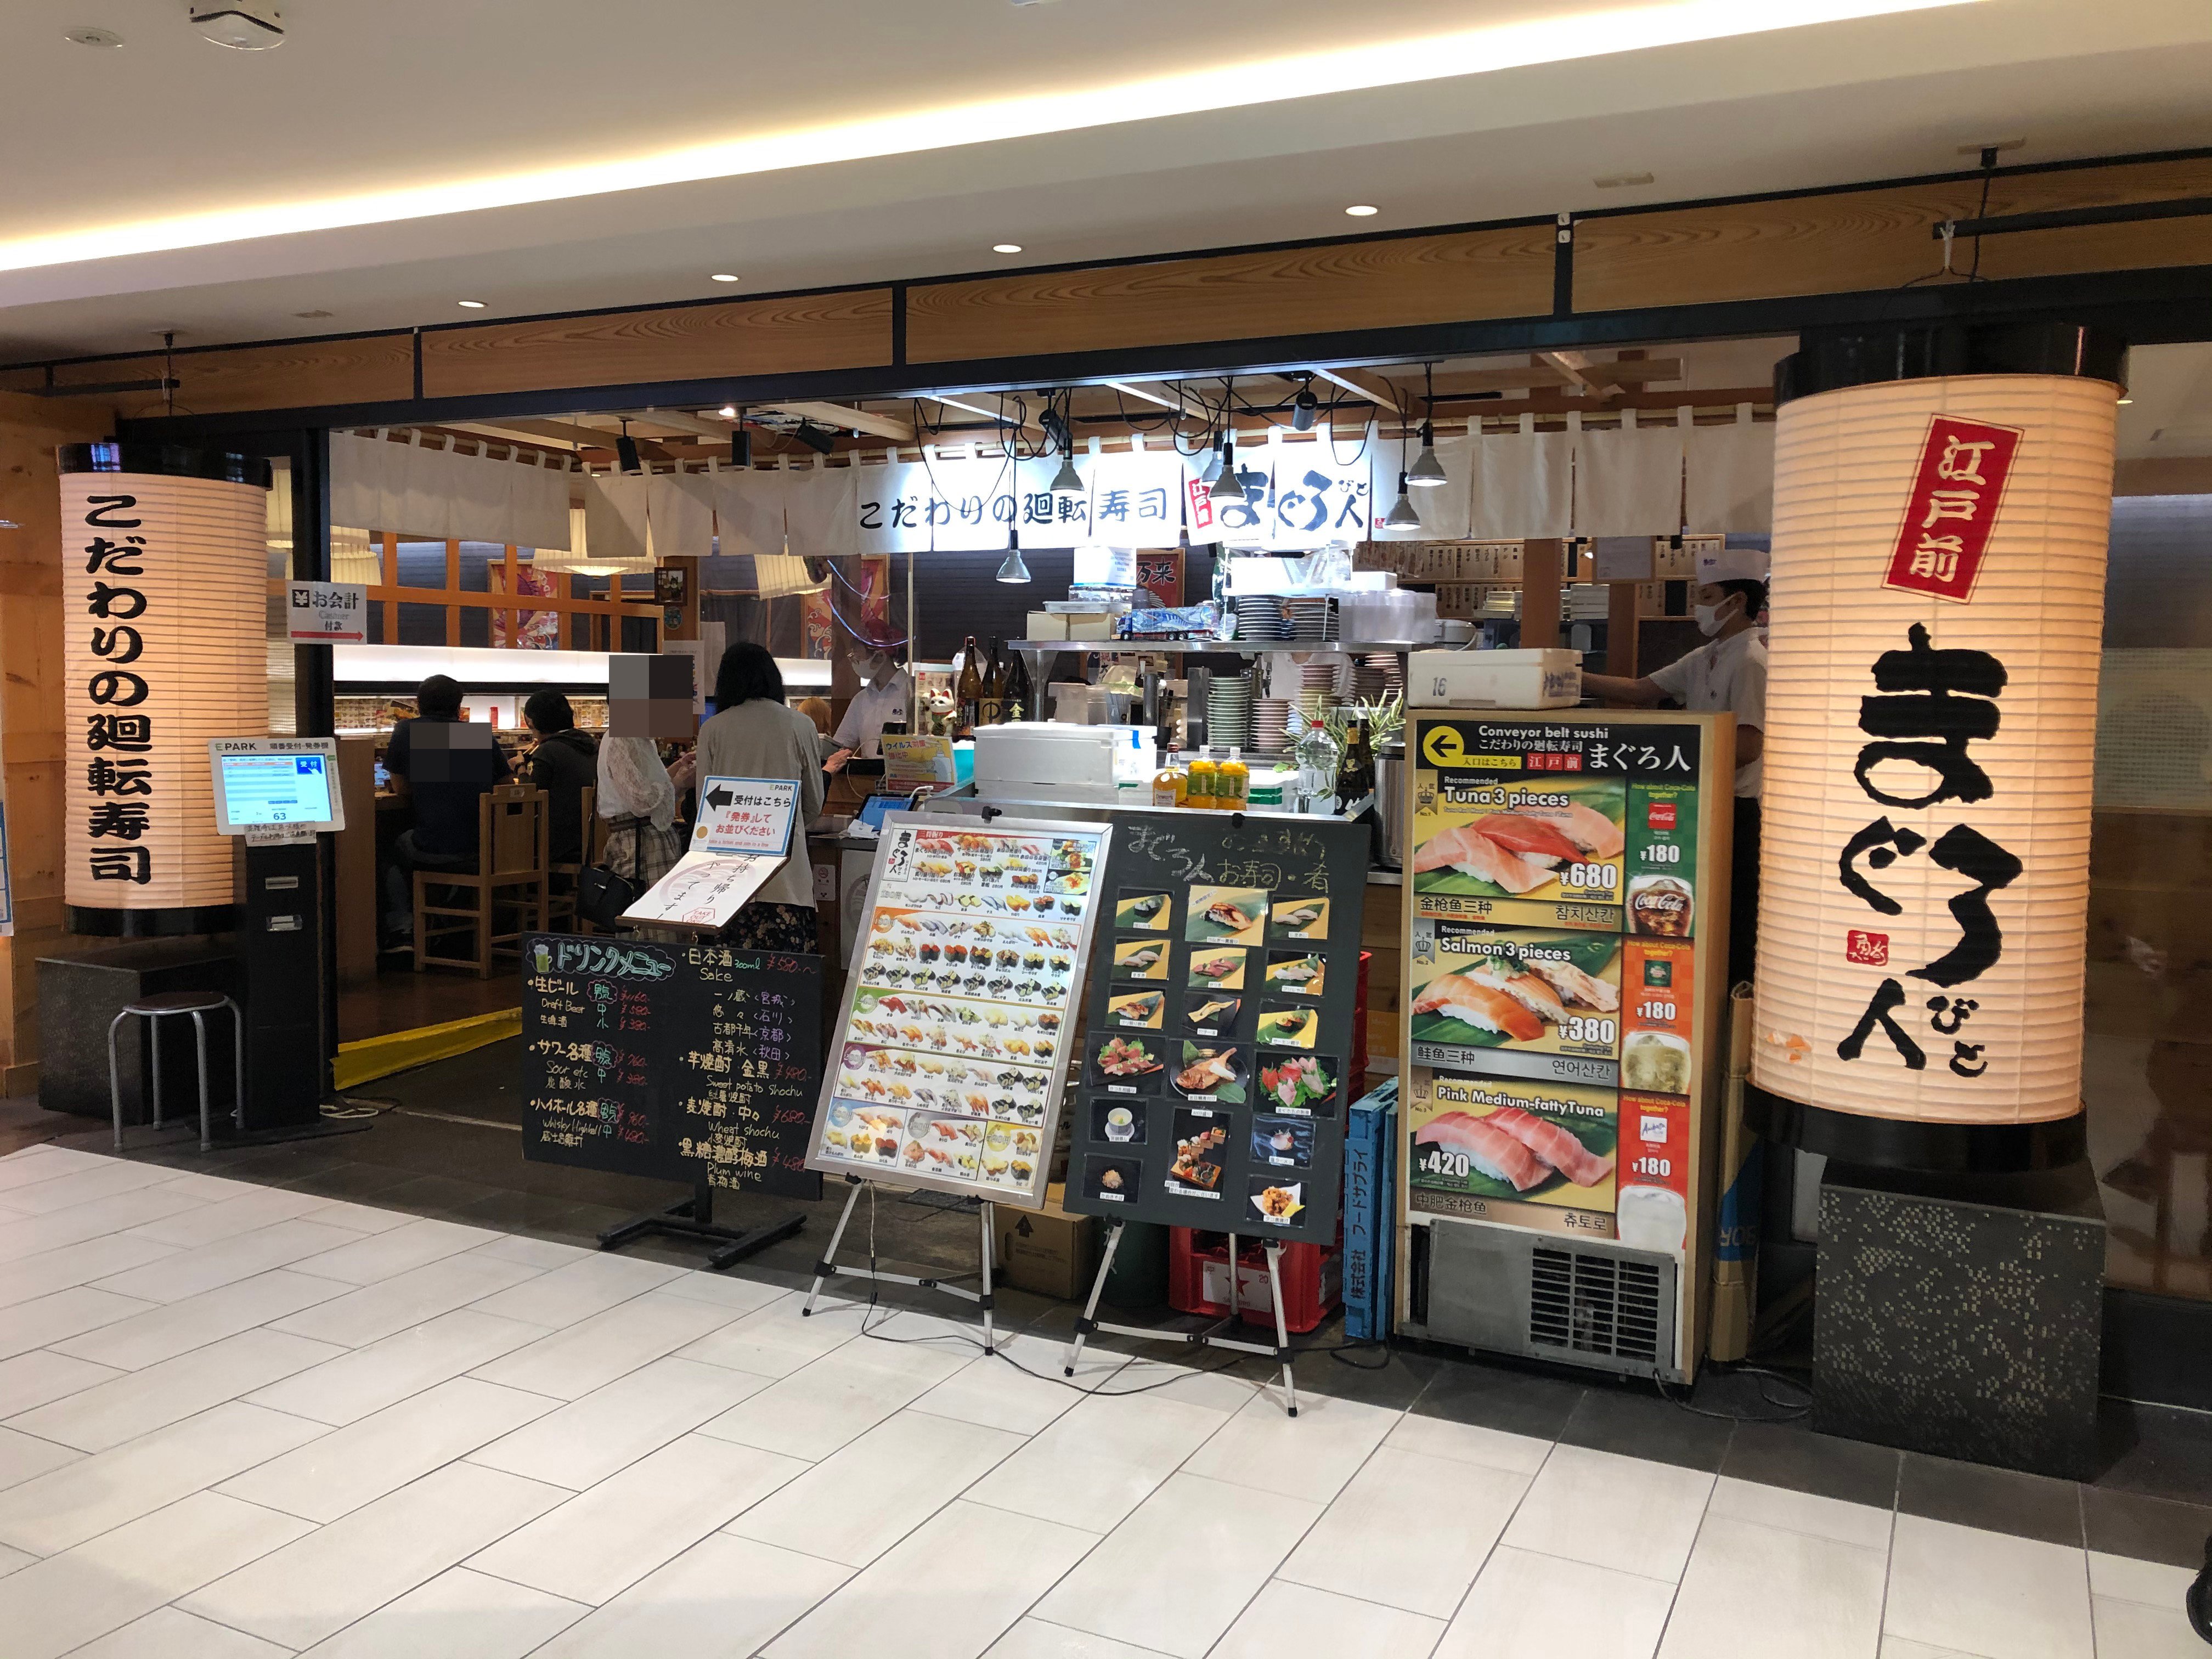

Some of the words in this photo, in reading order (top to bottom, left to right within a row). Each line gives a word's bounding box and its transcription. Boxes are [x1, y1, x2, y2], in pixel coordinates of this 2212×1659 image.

[861, 488, 1166, 529] こだわりの廻転寿司
[1910, 435, 1995, 582] 江戸前
[313, 591, 359, 610] お会計
[84, 495, 152, 884] こだわりの廻転寿司
[1432, 677, 1447, 697] 16
[1479, 725, 1542, 739] Conveyor
[1545, 727, 1569, 738] belt
[1573, 727, 1609, 739] sushi
[215, 743, 257, 751] EPARK
[1479, 739, 1583, 752] こだわりの廻転寿司
[1463, 758, 1517, 767] 入口はこちら
[1529, 756, 1578, 769] 江戸前
[1589, 743, 1691, 772] まぐろ人
[1444, 776, 1498, 785] Recommended
[734, 795, 791, 808] 受付はこちら
[1444, 786, 1491, 803] Tuna
[1493, 788, 1505, 804] 3
[1509, 788, 1569, 808] pieces
[273, 812, 286, 821] 63
[724, 811, 772, 824] 『発券』して
[715, 825, 775, 837] お並びください
[1128, 825, 1215, 883] まぐろ人
[1640, 844, 1680, 863] ¥180
[1560, 862, 1617, 889] ¥680
[1420, 897, 1493, 915] 金枪鱼三种
[1555, 905, 1615, 923] 참치산칸
[1441, 937, 1502, 956] Salmon
[1505, 943, 1515, 956] 3
[1519, 944, 1571, 961] pieces
[557, 943, 672, 976] ドリンクメニュー
[689, 948, 732, 967] 日本酒
[735, 957, 760, 970] 300ml
[699, 968, 733, 982] Sake
[535, 975, 579, 995] 生ビール
[541, 998, 563, 1009] Draft
[566, 1000, 585, 1014] Beer
[597, 1003, 606, 1016] 中
[1637, 1001, 1676, 1020] ¥180
[596, 1017, 609, 1029] 小
[1559, 1016, 1616, 1043] ¥380
[537, 1039, 592, 1062] サワー各種
[546, 1060, 571, 1074] Sour
[573, 1066, 588, 1079] etc
[597, 1068, 606, 1084] 中
[1551, 1060, 1611, 1080] 연어산칸
[706, 1075, 732, 1087] Sweet
[736, 1080, 764, 1093] potato
[768, 1084, 803, 1097] Shochu
[1437, 1086, 1468, 1103] Pink
[535, 1098, 599, 1118] ハイボール各種
[603, 1125, 612, 1139] 中
[708, 1121, 740, 1134] Wheat
[743, 1124, 780, 1139] shochu
[707, 1161, 731, 1176] Plum
[735, 1165, 762, 1182] wine
[1419, 1150, 1470, 1178] ¥420
[1632, 1156, 1671, 1176] ¥180
[1352, 1148, 1368, 1236] フードサプライ
[1415, 1193, 1487, 1216] 中肥金枪鱼
[1564, 1212, 1607, 1231] 츄토로
[1258, 1274, 1269, 1284] 20
[1350, 1249, 1367, 1300] 株式会社
